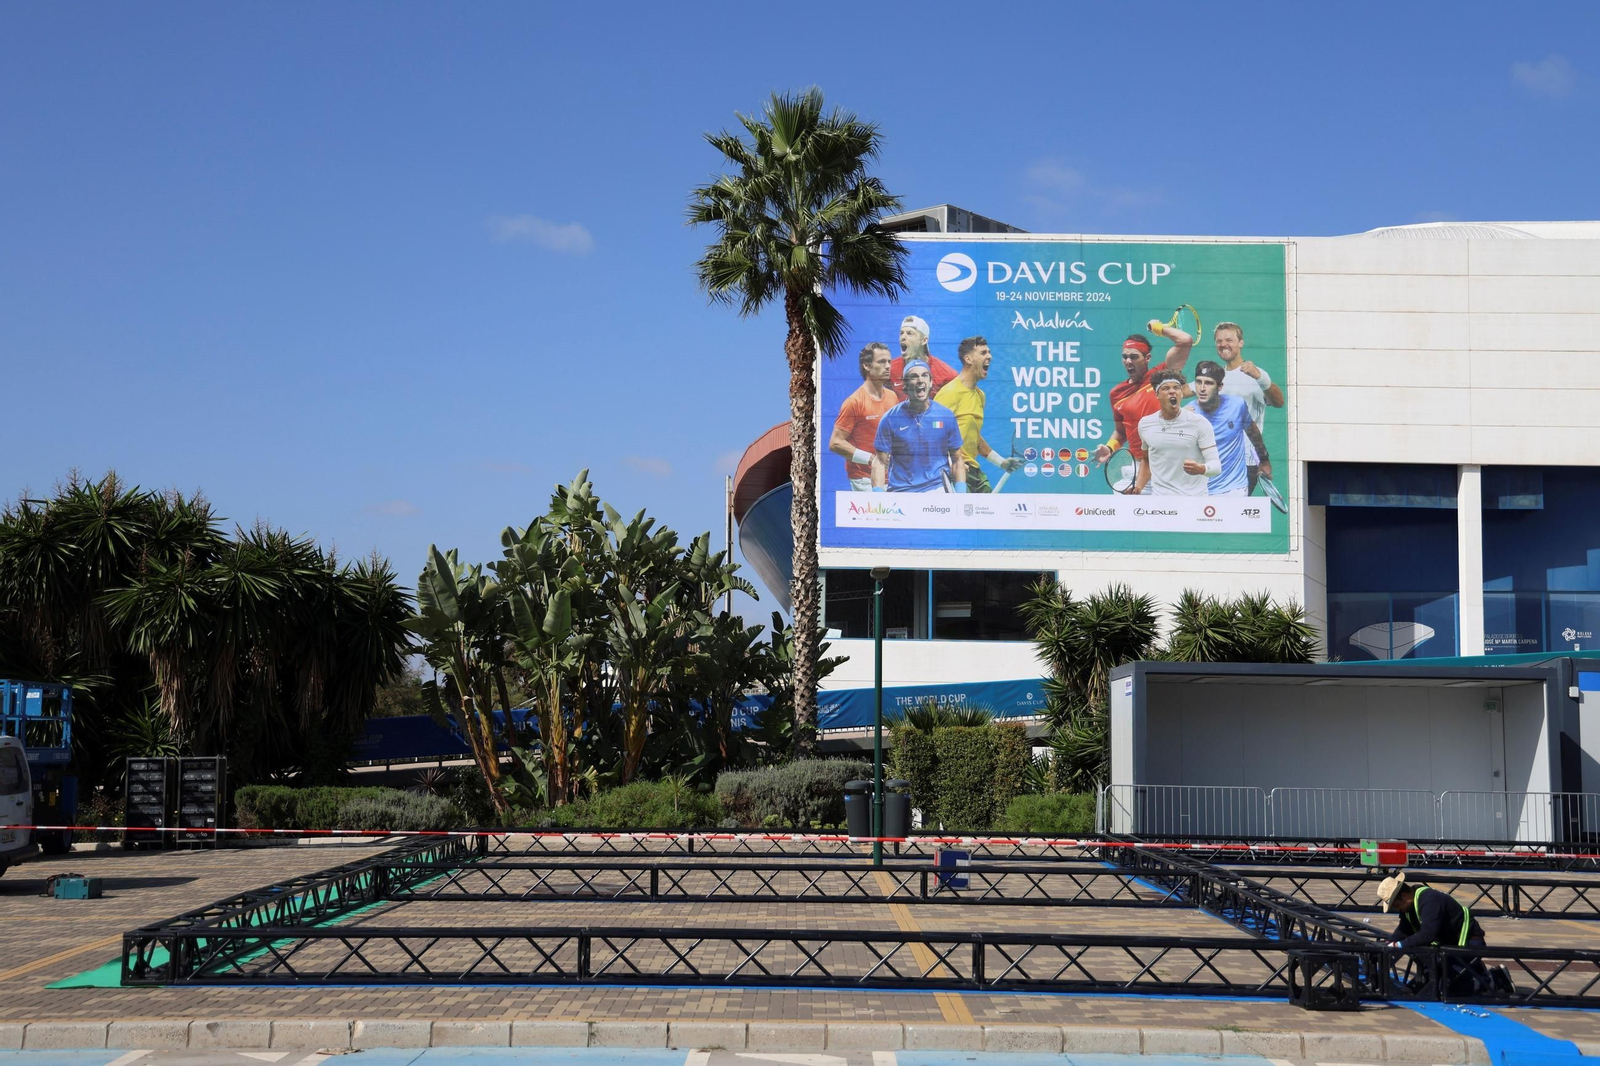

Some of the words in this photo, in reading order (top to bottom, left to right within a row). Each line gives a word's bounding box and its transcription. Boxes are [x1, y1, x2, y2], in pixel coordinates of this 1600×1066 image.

[987, 261, 1087, 284] DAVIS
[996, 291, 1022, 301] 19-24
[1024, 291, 1084, 302] NOVIEMBRE
[1086, 292, 1111, 302] 2024
[1031, 341, 1080, 362] THE
[1011, 366, 1101, 388] WORLD
[1012, 391, 1062, 413] CUP
[1068, 392, 1100, 414] OF
[1011, 417, 1102, 439] TENNIS
[1083, 507, 1116, 516] UniCredit
[895, 696, 913, 705] THE
[948, 693, 966, 702] CUP
